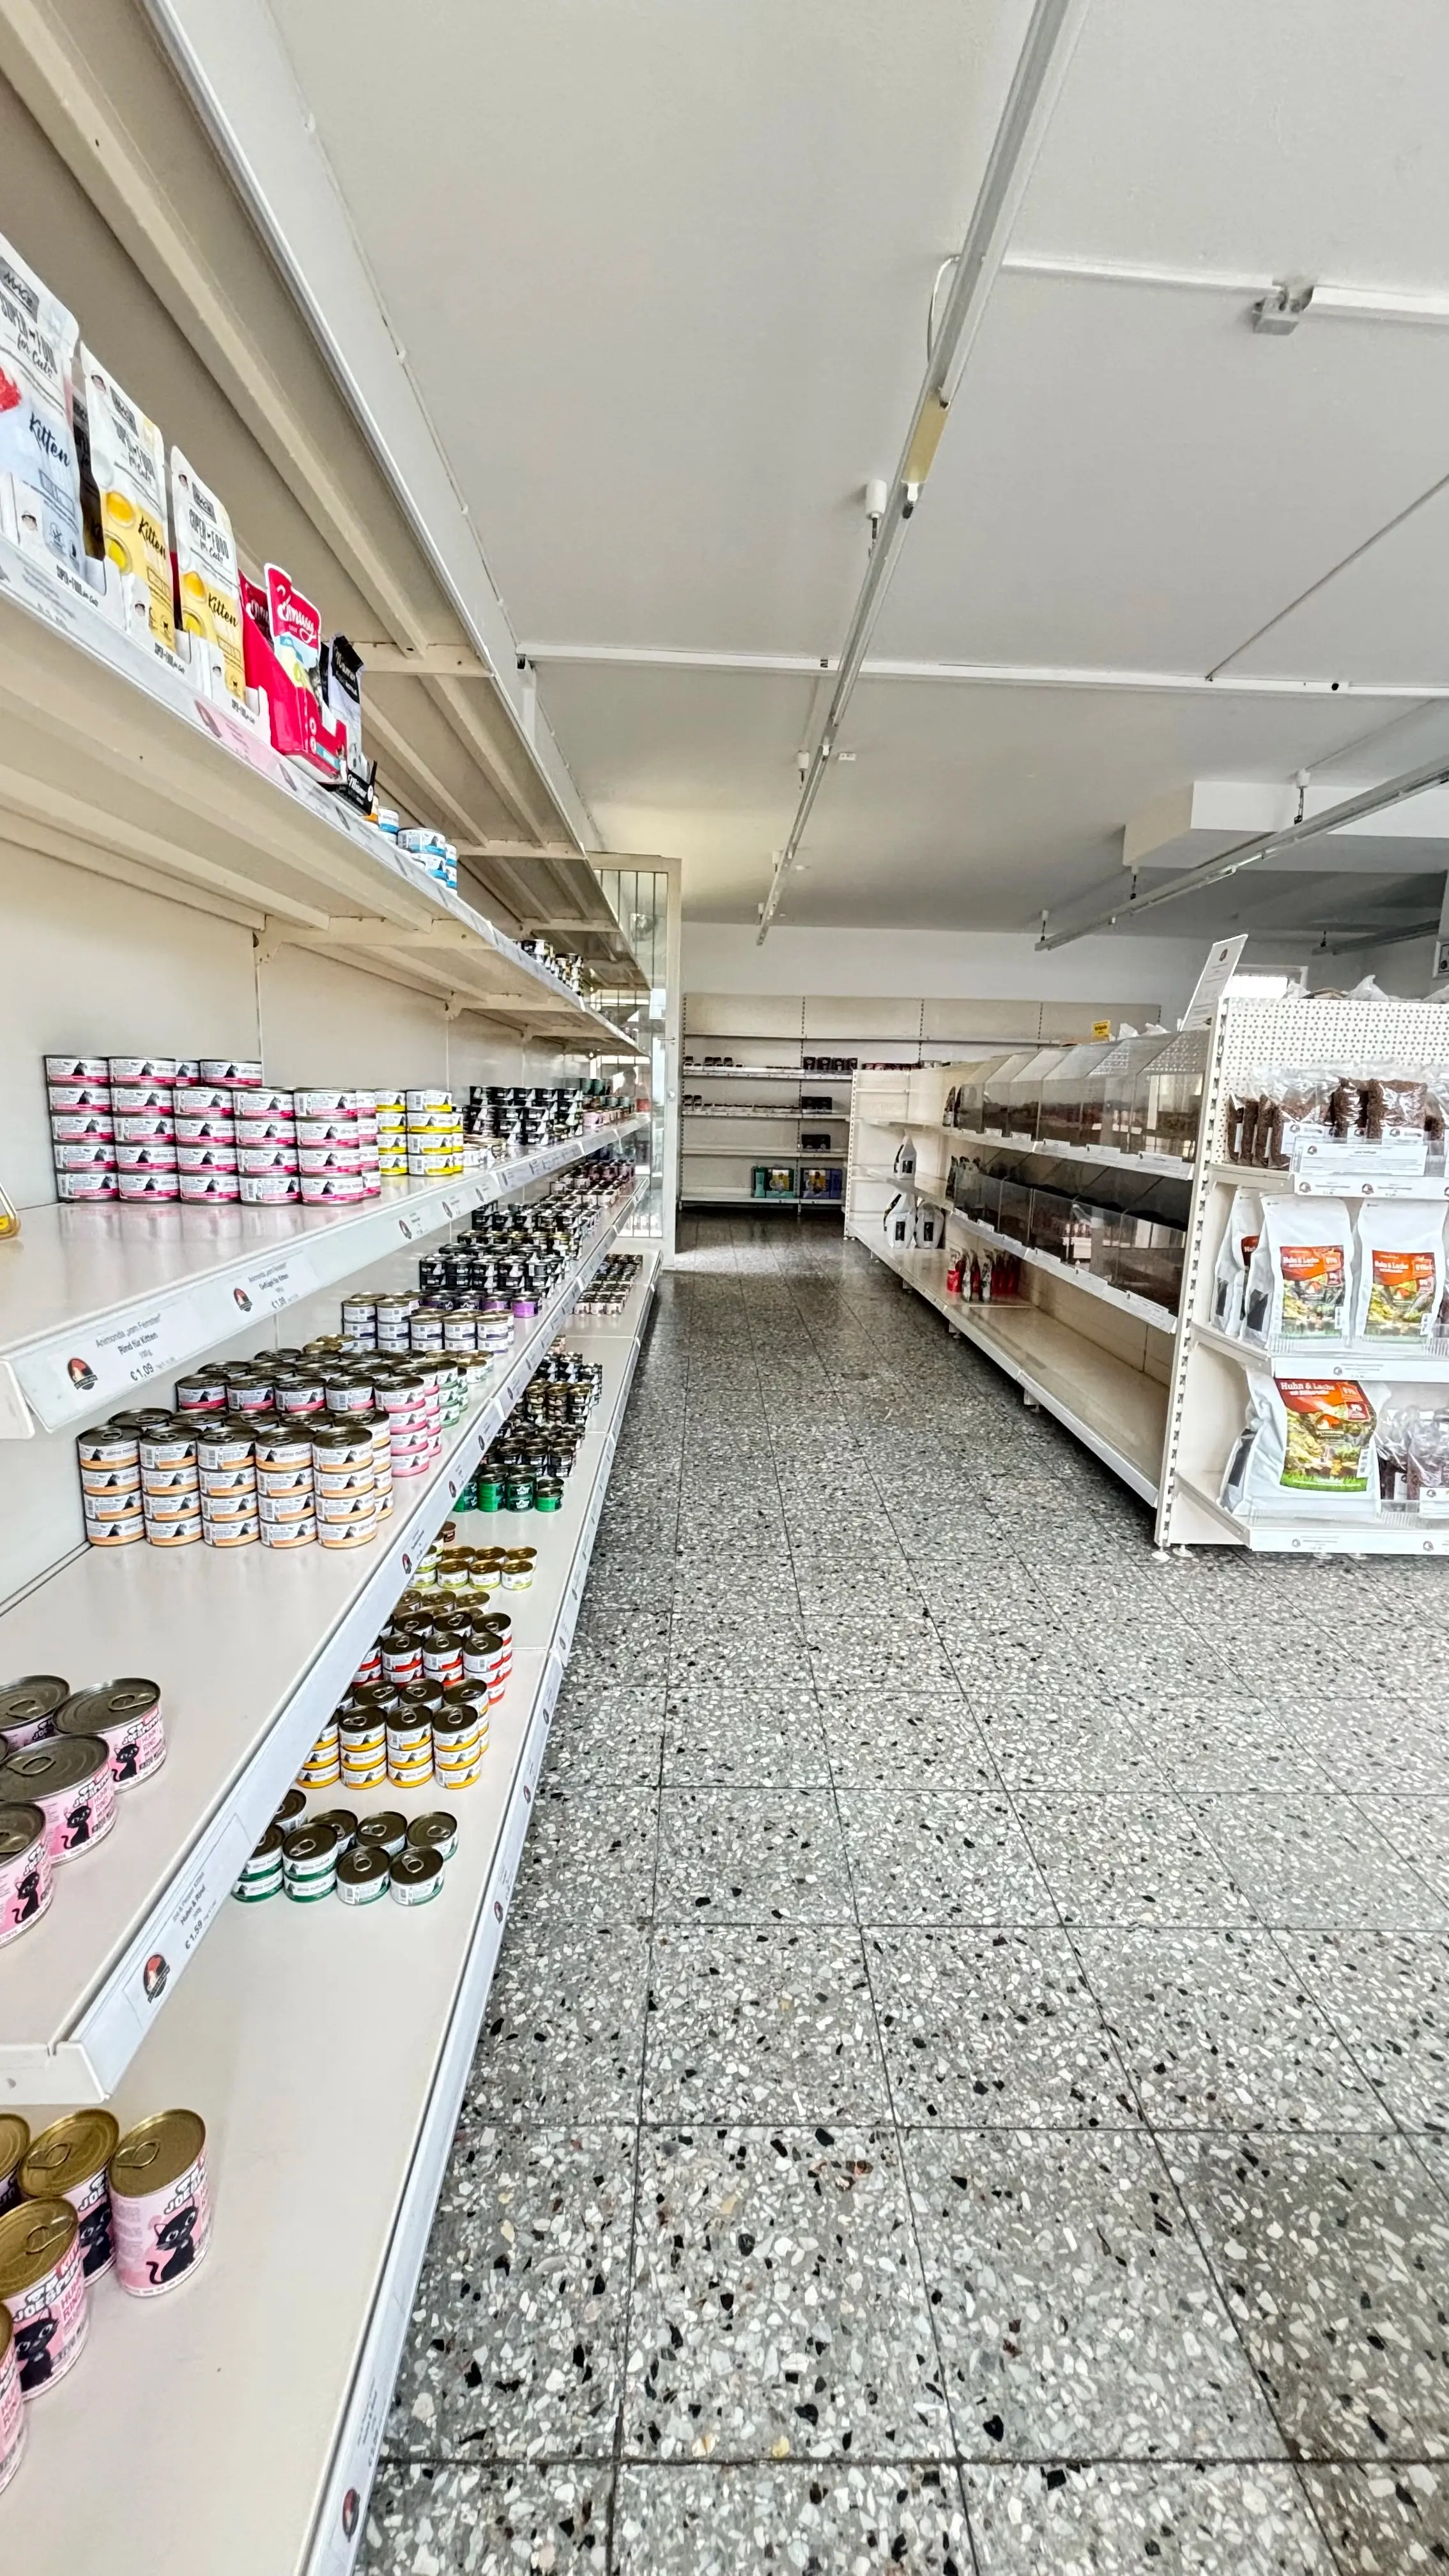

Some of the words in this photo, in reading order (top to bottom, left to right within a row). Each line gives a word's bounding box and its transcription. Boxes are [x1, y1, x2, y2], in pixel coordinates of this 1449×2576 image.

[29, 411, 71, 468] Kitten
[138, 516, 167, 560] Kitten
[208, 592, 239, 628] Kitten
[118, 1342, 134, 1356] Rind
[132, 1338, 142, 1349] für
[139, 1331, 159, 1347] Kitten
[130, 1370, 138, 1382] €
[136, 1362, 155, 1379] 1,09
[1280, 1382, 1305, 1390] Huhn
[180, 1906, 193, 1926] Huhn
[195, 1884, 206, 1902] Rind
[185, 1939, 191, 1950] €
[190, 1919, 203, 1942] 1,59
